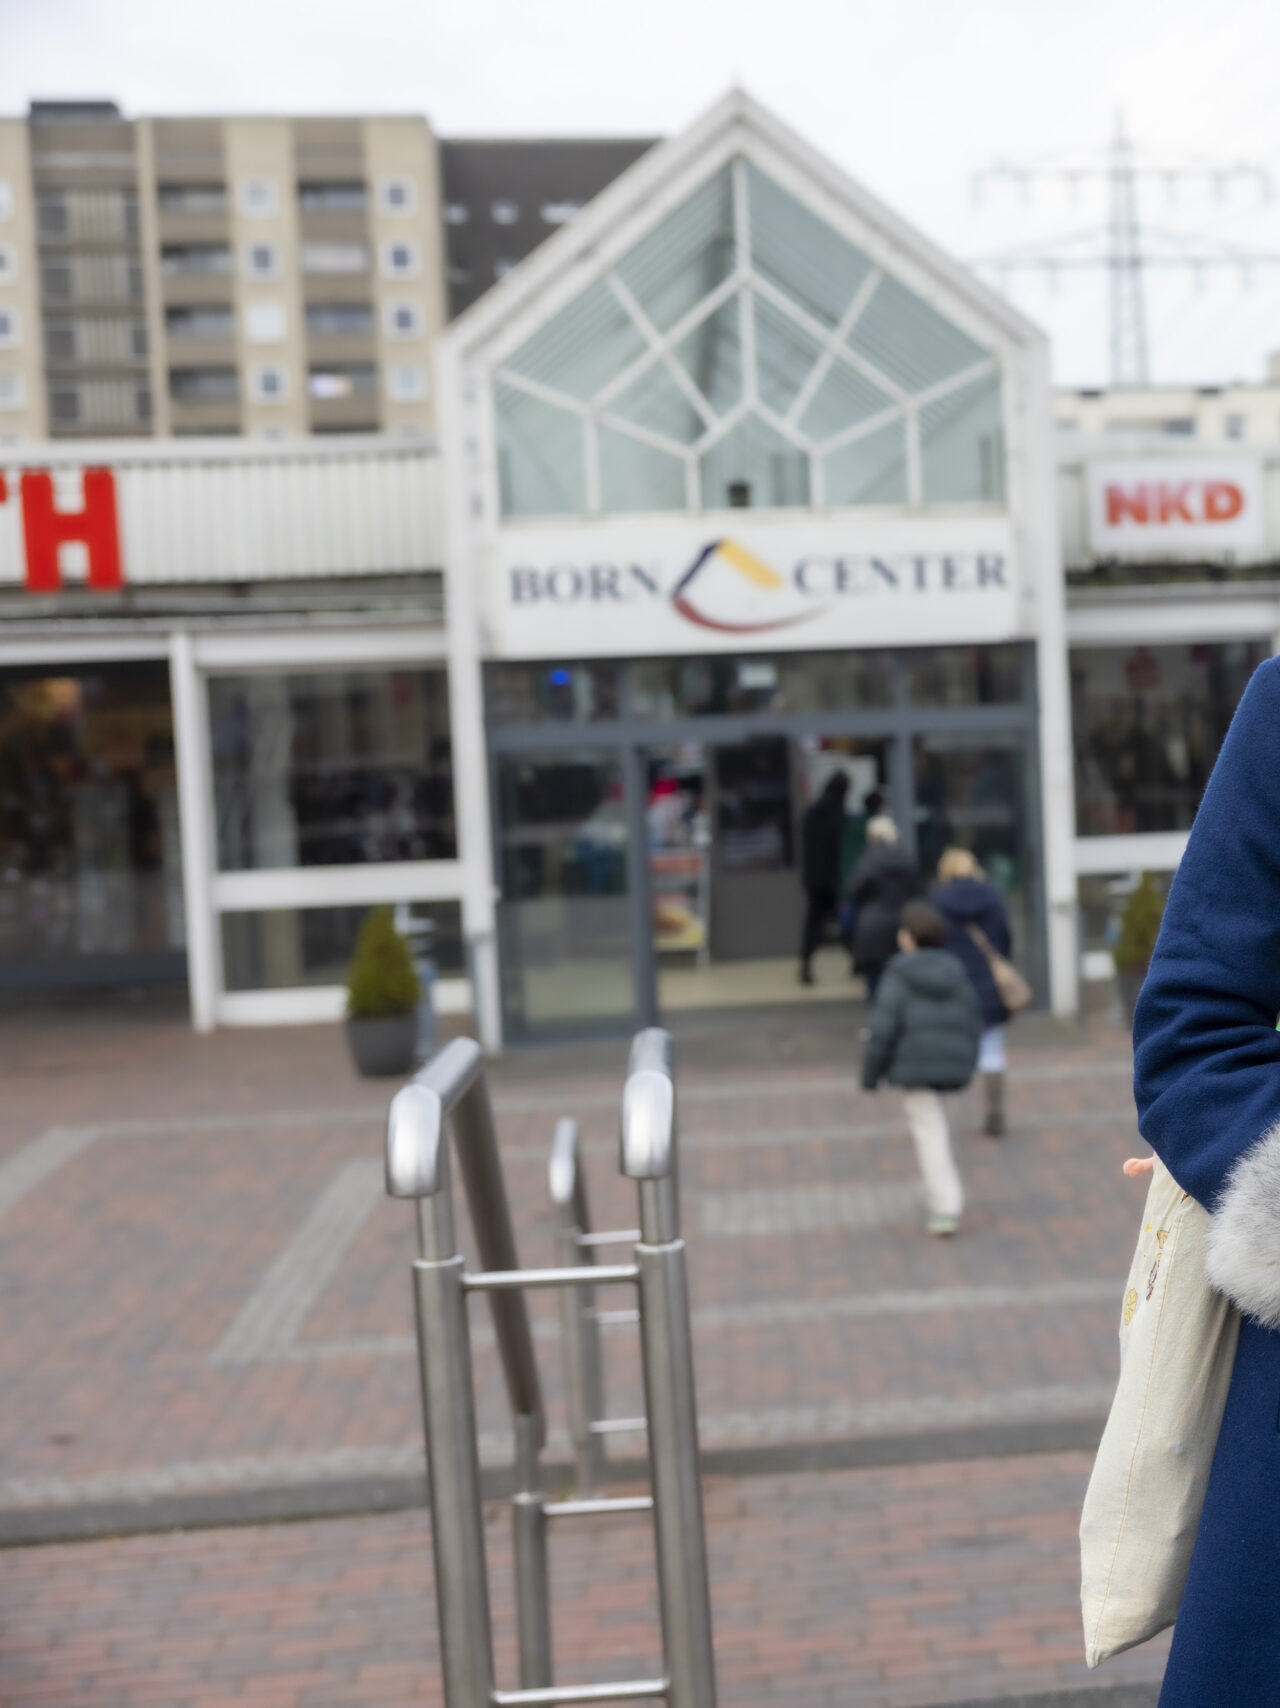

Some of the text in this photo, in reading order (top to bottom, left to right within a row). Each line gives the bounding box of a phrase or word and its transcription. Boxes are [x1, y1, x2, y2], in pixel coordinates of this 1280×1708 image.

[1104, 478, 1244, 525] NKD
[0, 466, 123, 592] H
[510, 552, 1006, 605] BORN CENTER
